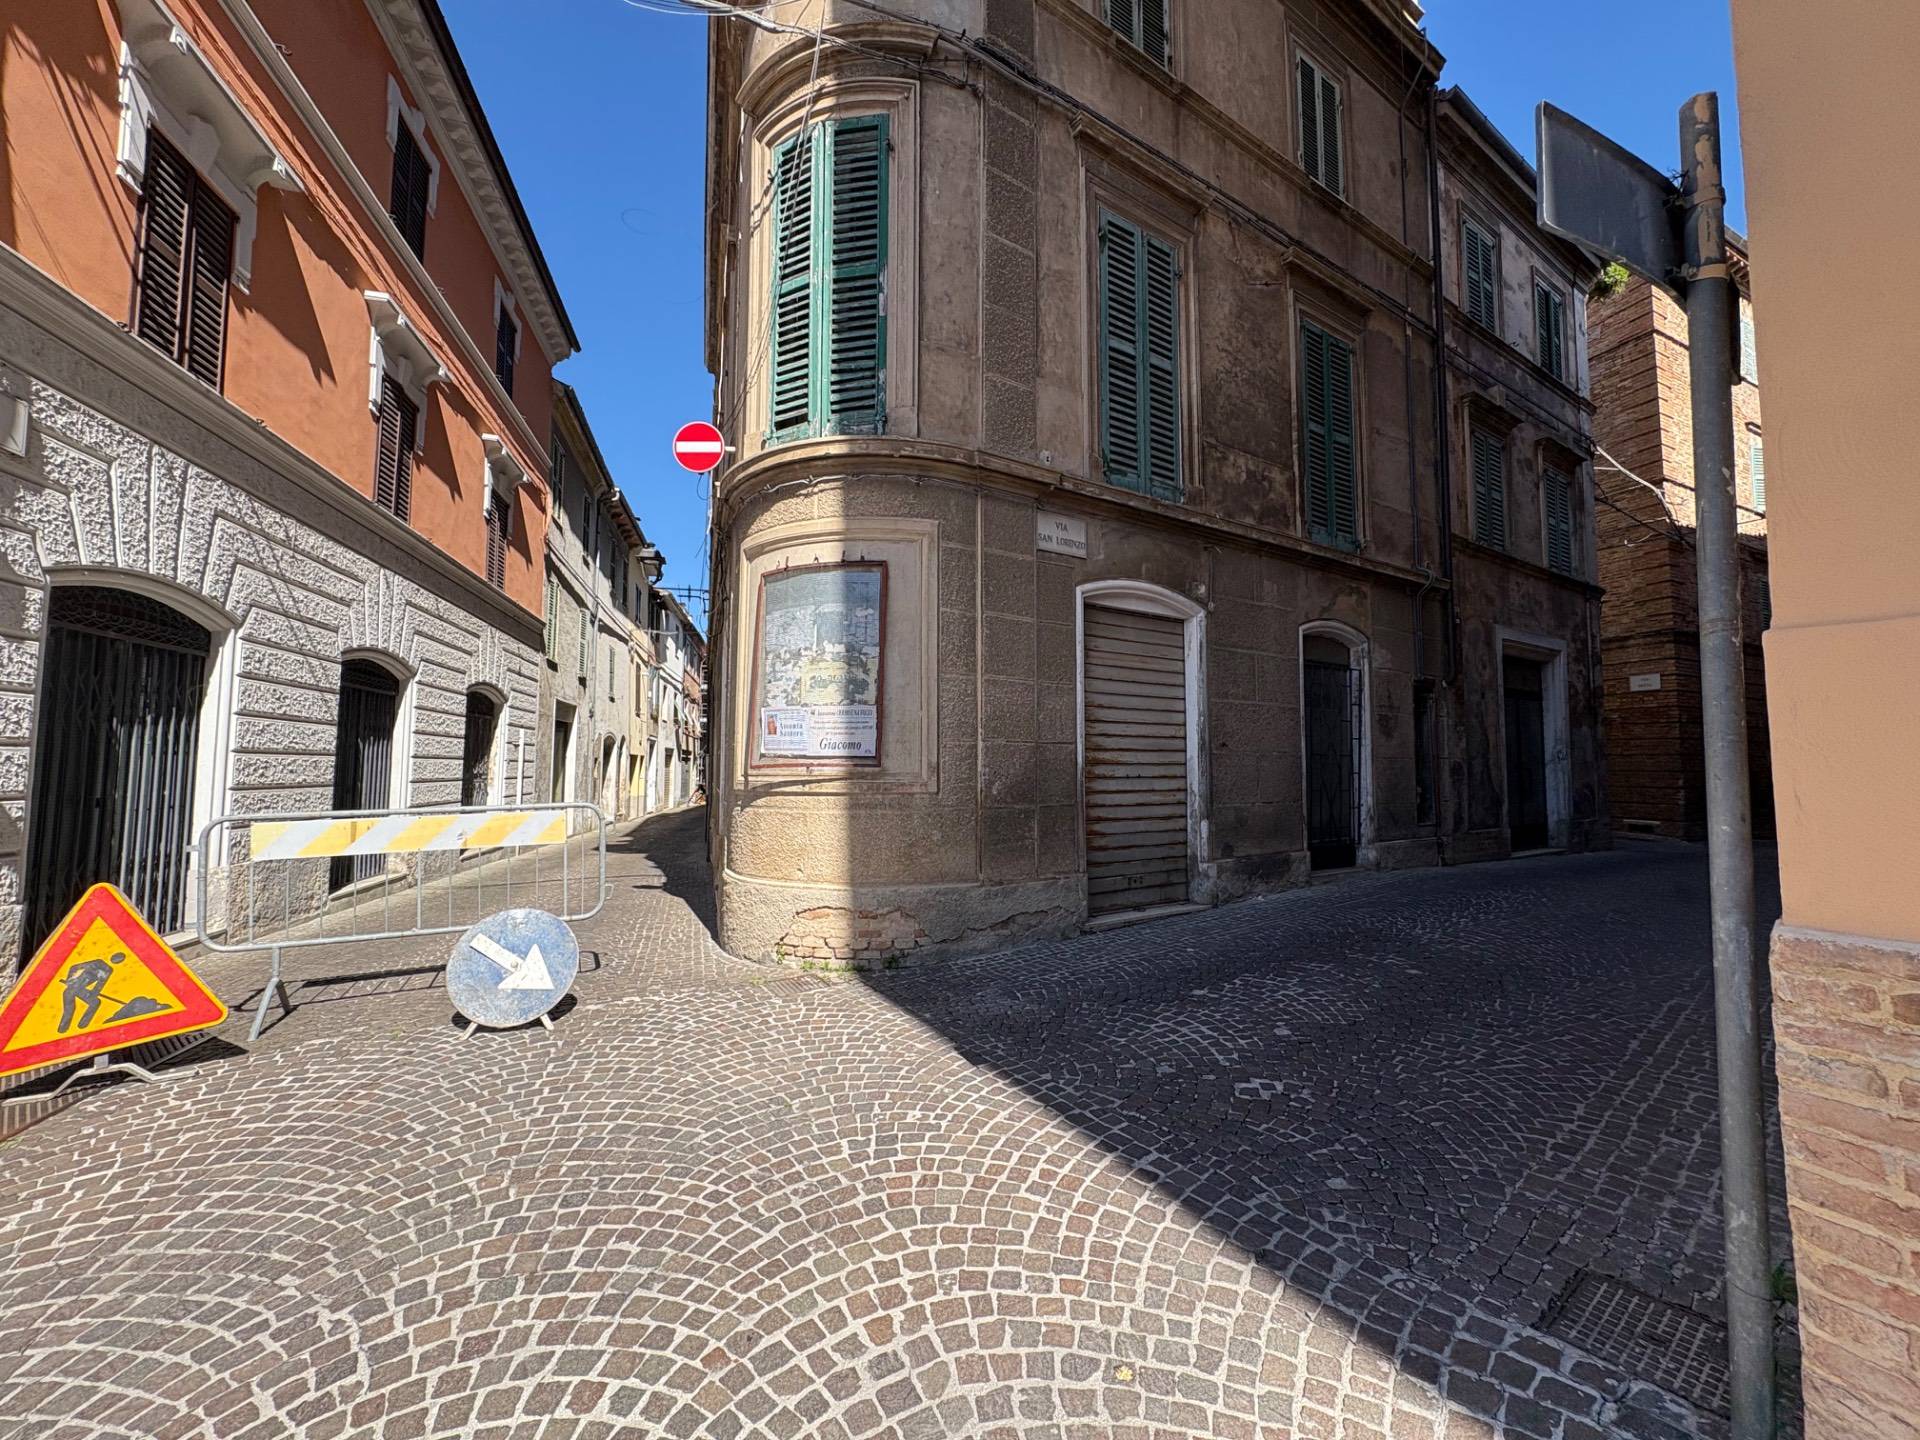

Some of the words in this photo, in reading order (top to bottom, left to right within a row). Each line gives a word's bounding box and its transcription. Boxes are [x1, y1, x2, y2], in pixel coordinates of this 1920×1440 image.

[1055, 521, 1069, 532] VIA
[1038, 533, 1053, 543] SAN
[819, 737, 862, 751] Giacomo
